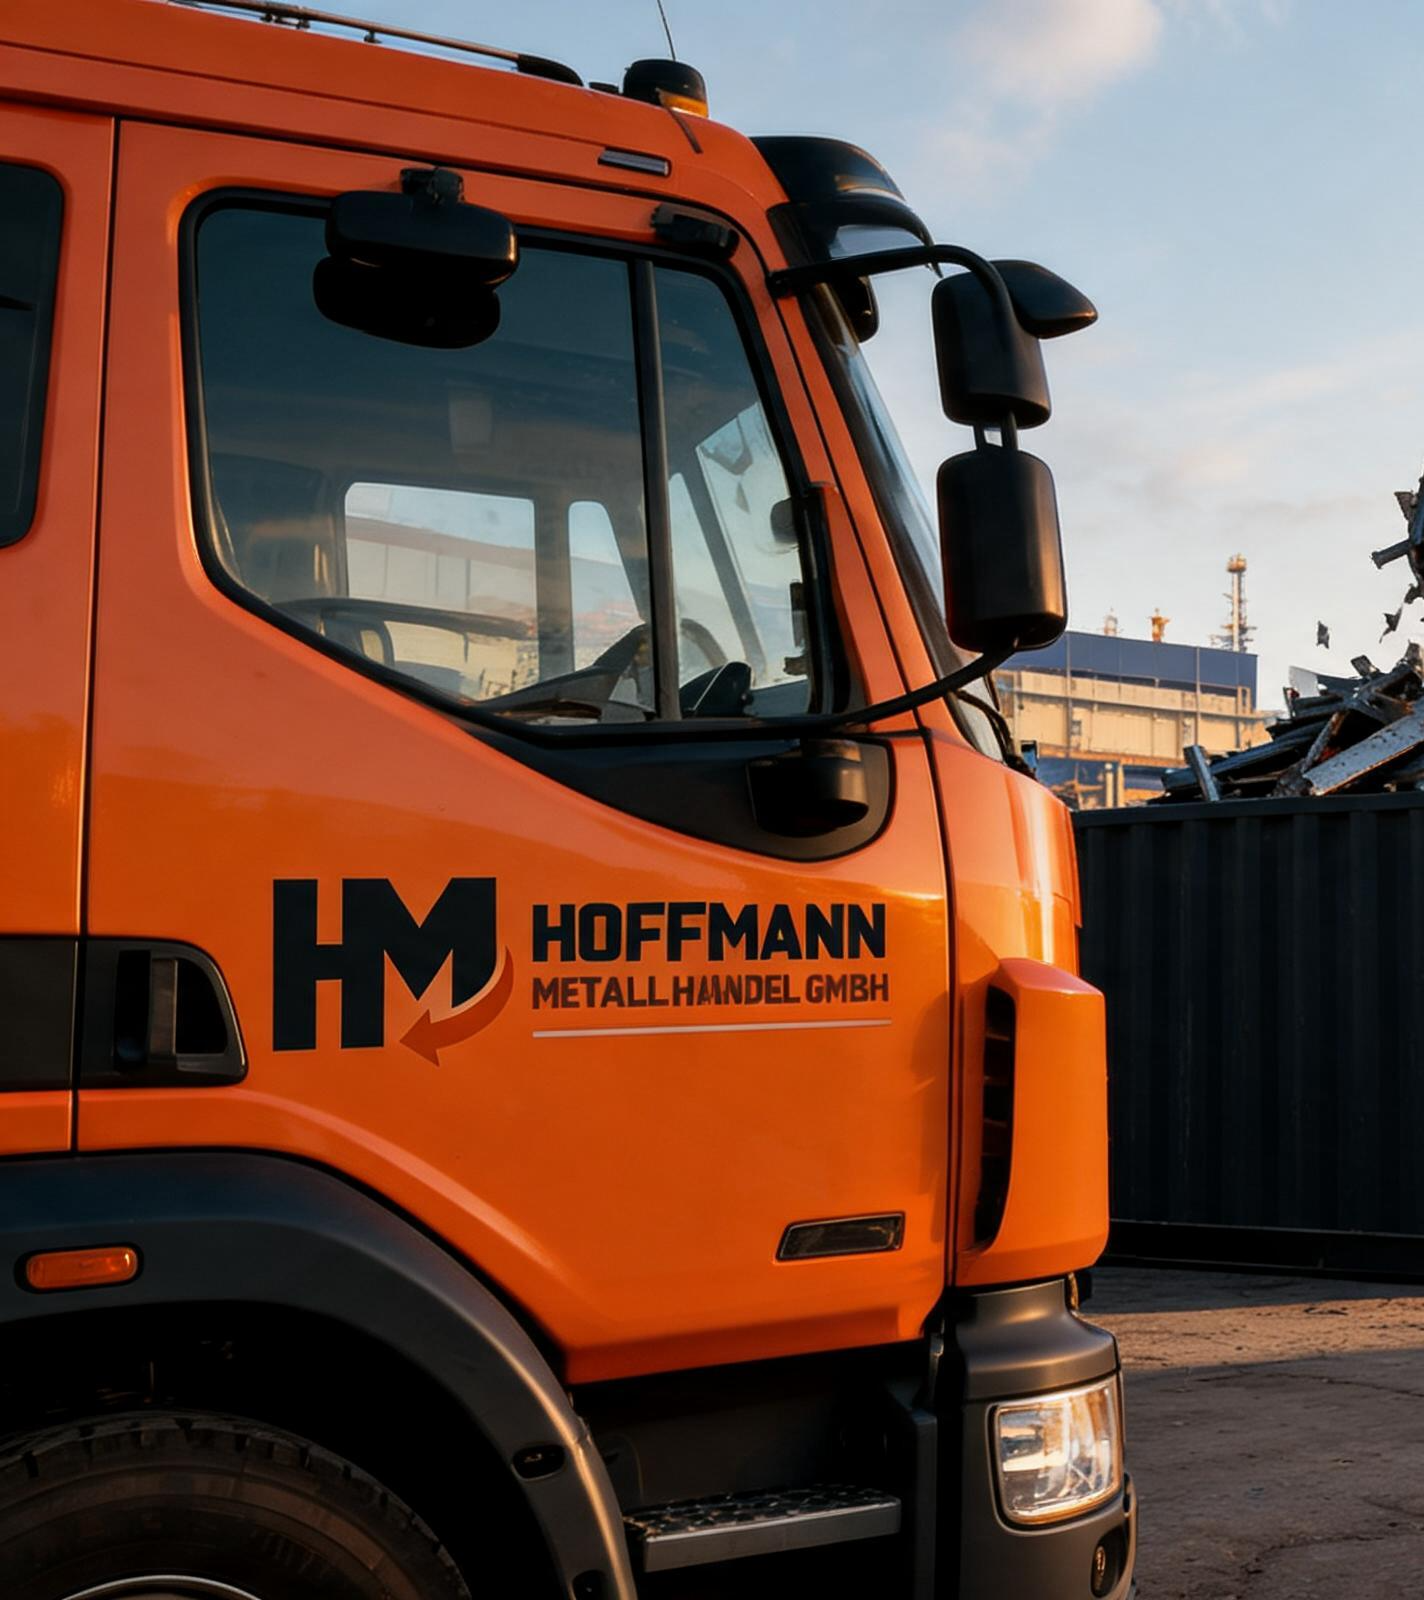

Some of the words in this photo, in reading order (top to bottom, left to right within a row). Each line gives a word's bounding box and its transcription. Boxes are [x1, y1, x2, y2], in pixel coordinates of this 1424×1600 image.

[532, 902, 886, 962] HOFFMANN
[273, 877, 497, 1051] HM
[805, 973, 889, 1004] GMBH
